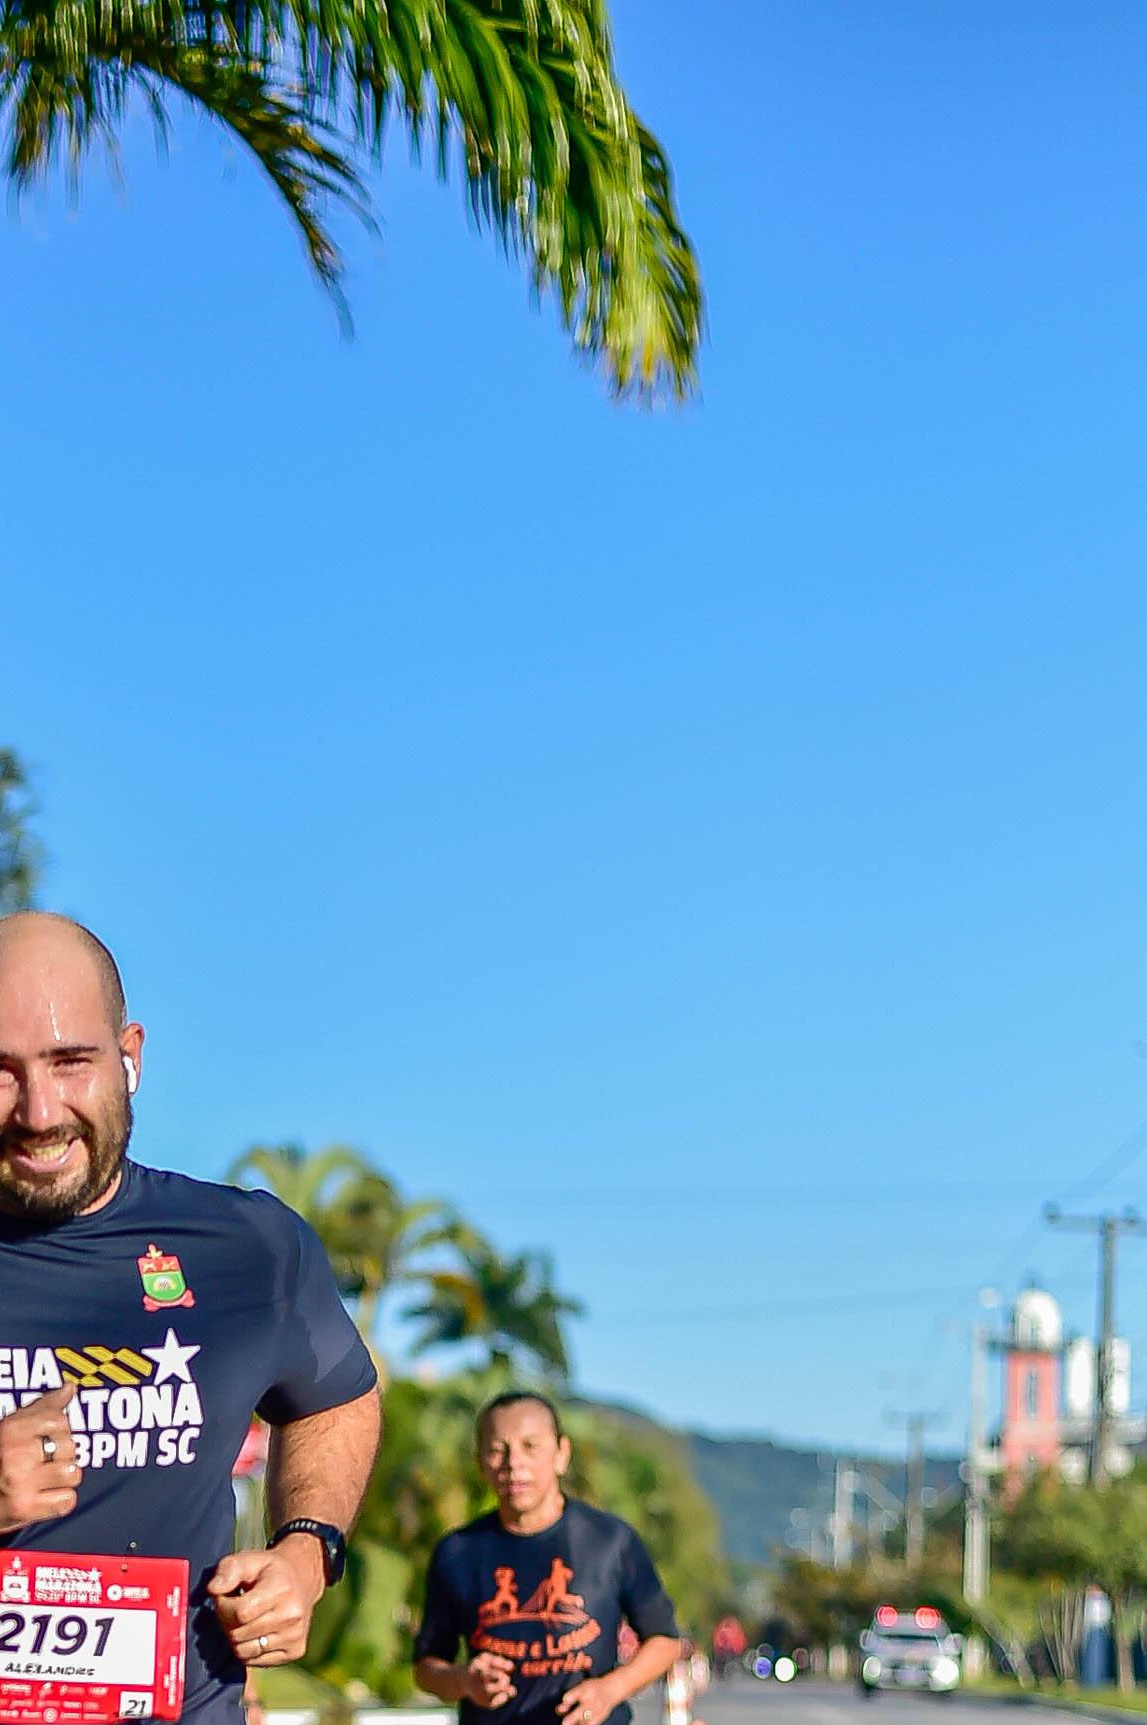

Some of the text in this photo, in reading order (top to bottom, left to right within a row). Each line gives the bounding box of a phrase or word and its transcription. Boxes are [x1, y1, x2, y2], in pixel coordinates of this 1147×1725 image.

[156, 1428, 200, 1465] SC
[4, 1660, 95, 1676] ALEXANDRE
[124, 1699, 147, 1717] 21
